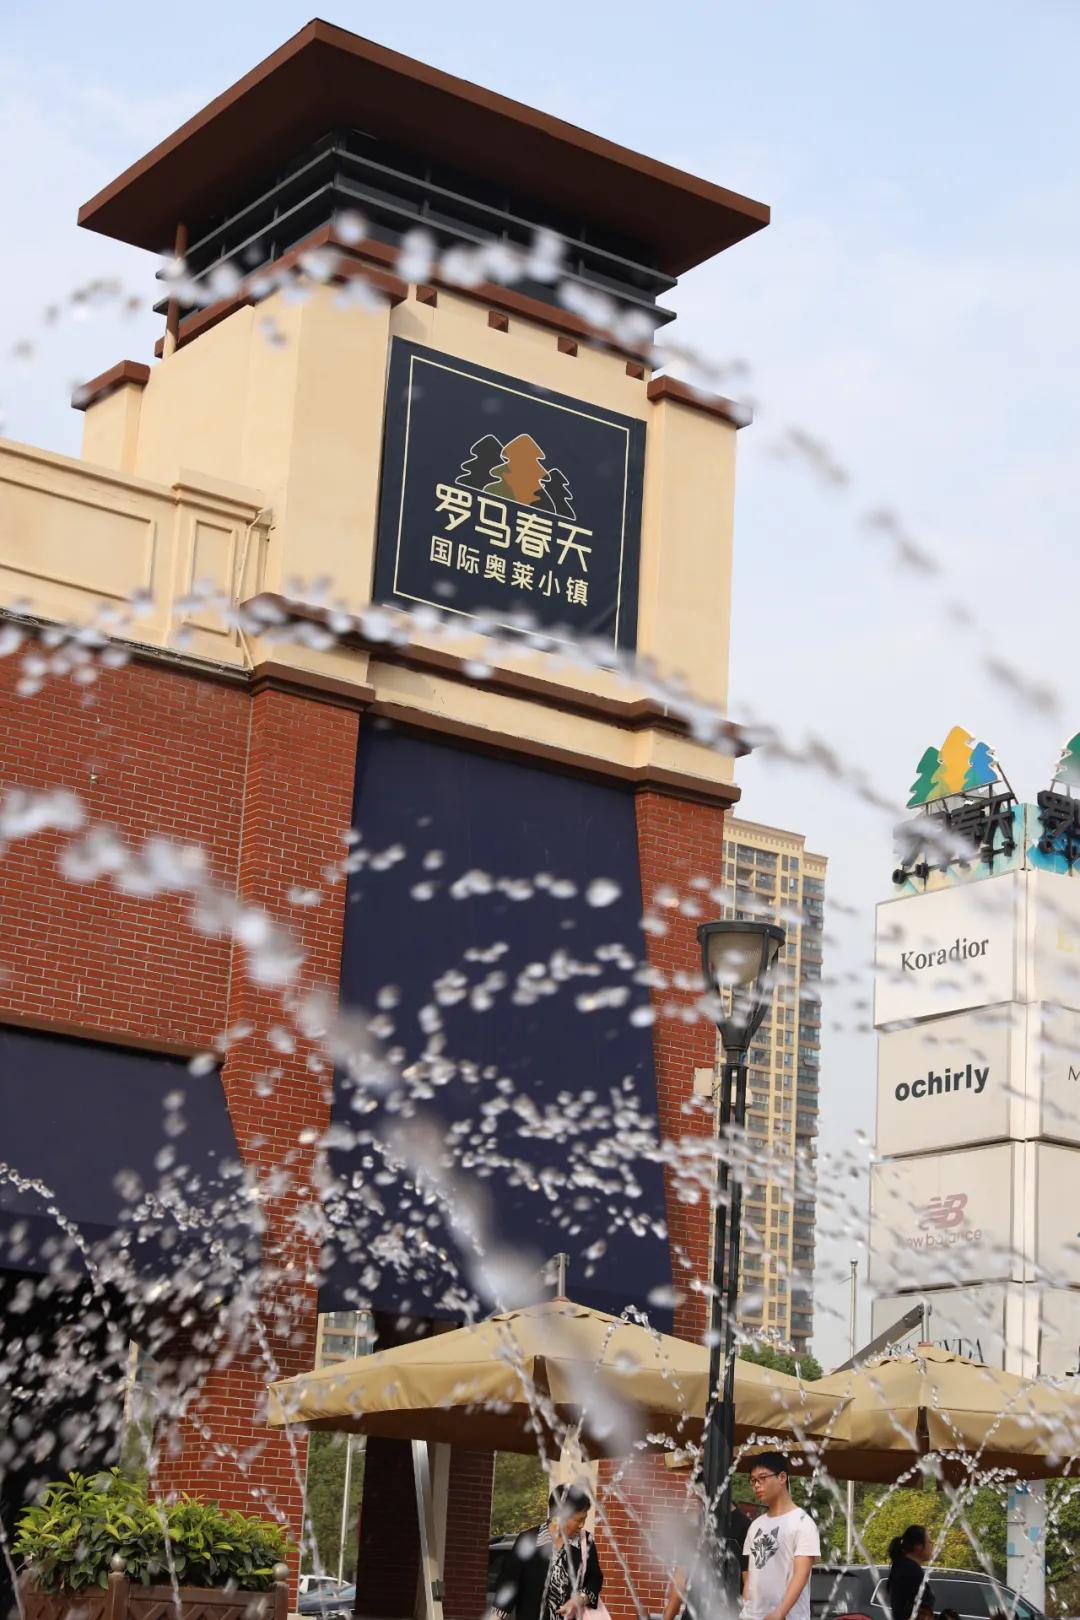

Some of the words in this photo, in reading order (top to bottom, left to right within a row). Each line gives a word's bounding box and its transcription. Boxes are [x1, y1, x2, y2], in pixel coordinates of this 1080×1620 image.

[434, 483, 593, 573] 罗马春天
[429, 535, 589, 607] 国际奥莱小镇
[901, 937, 989, 971] Koradior
[894, 1064, 990, 1102] ochirly
